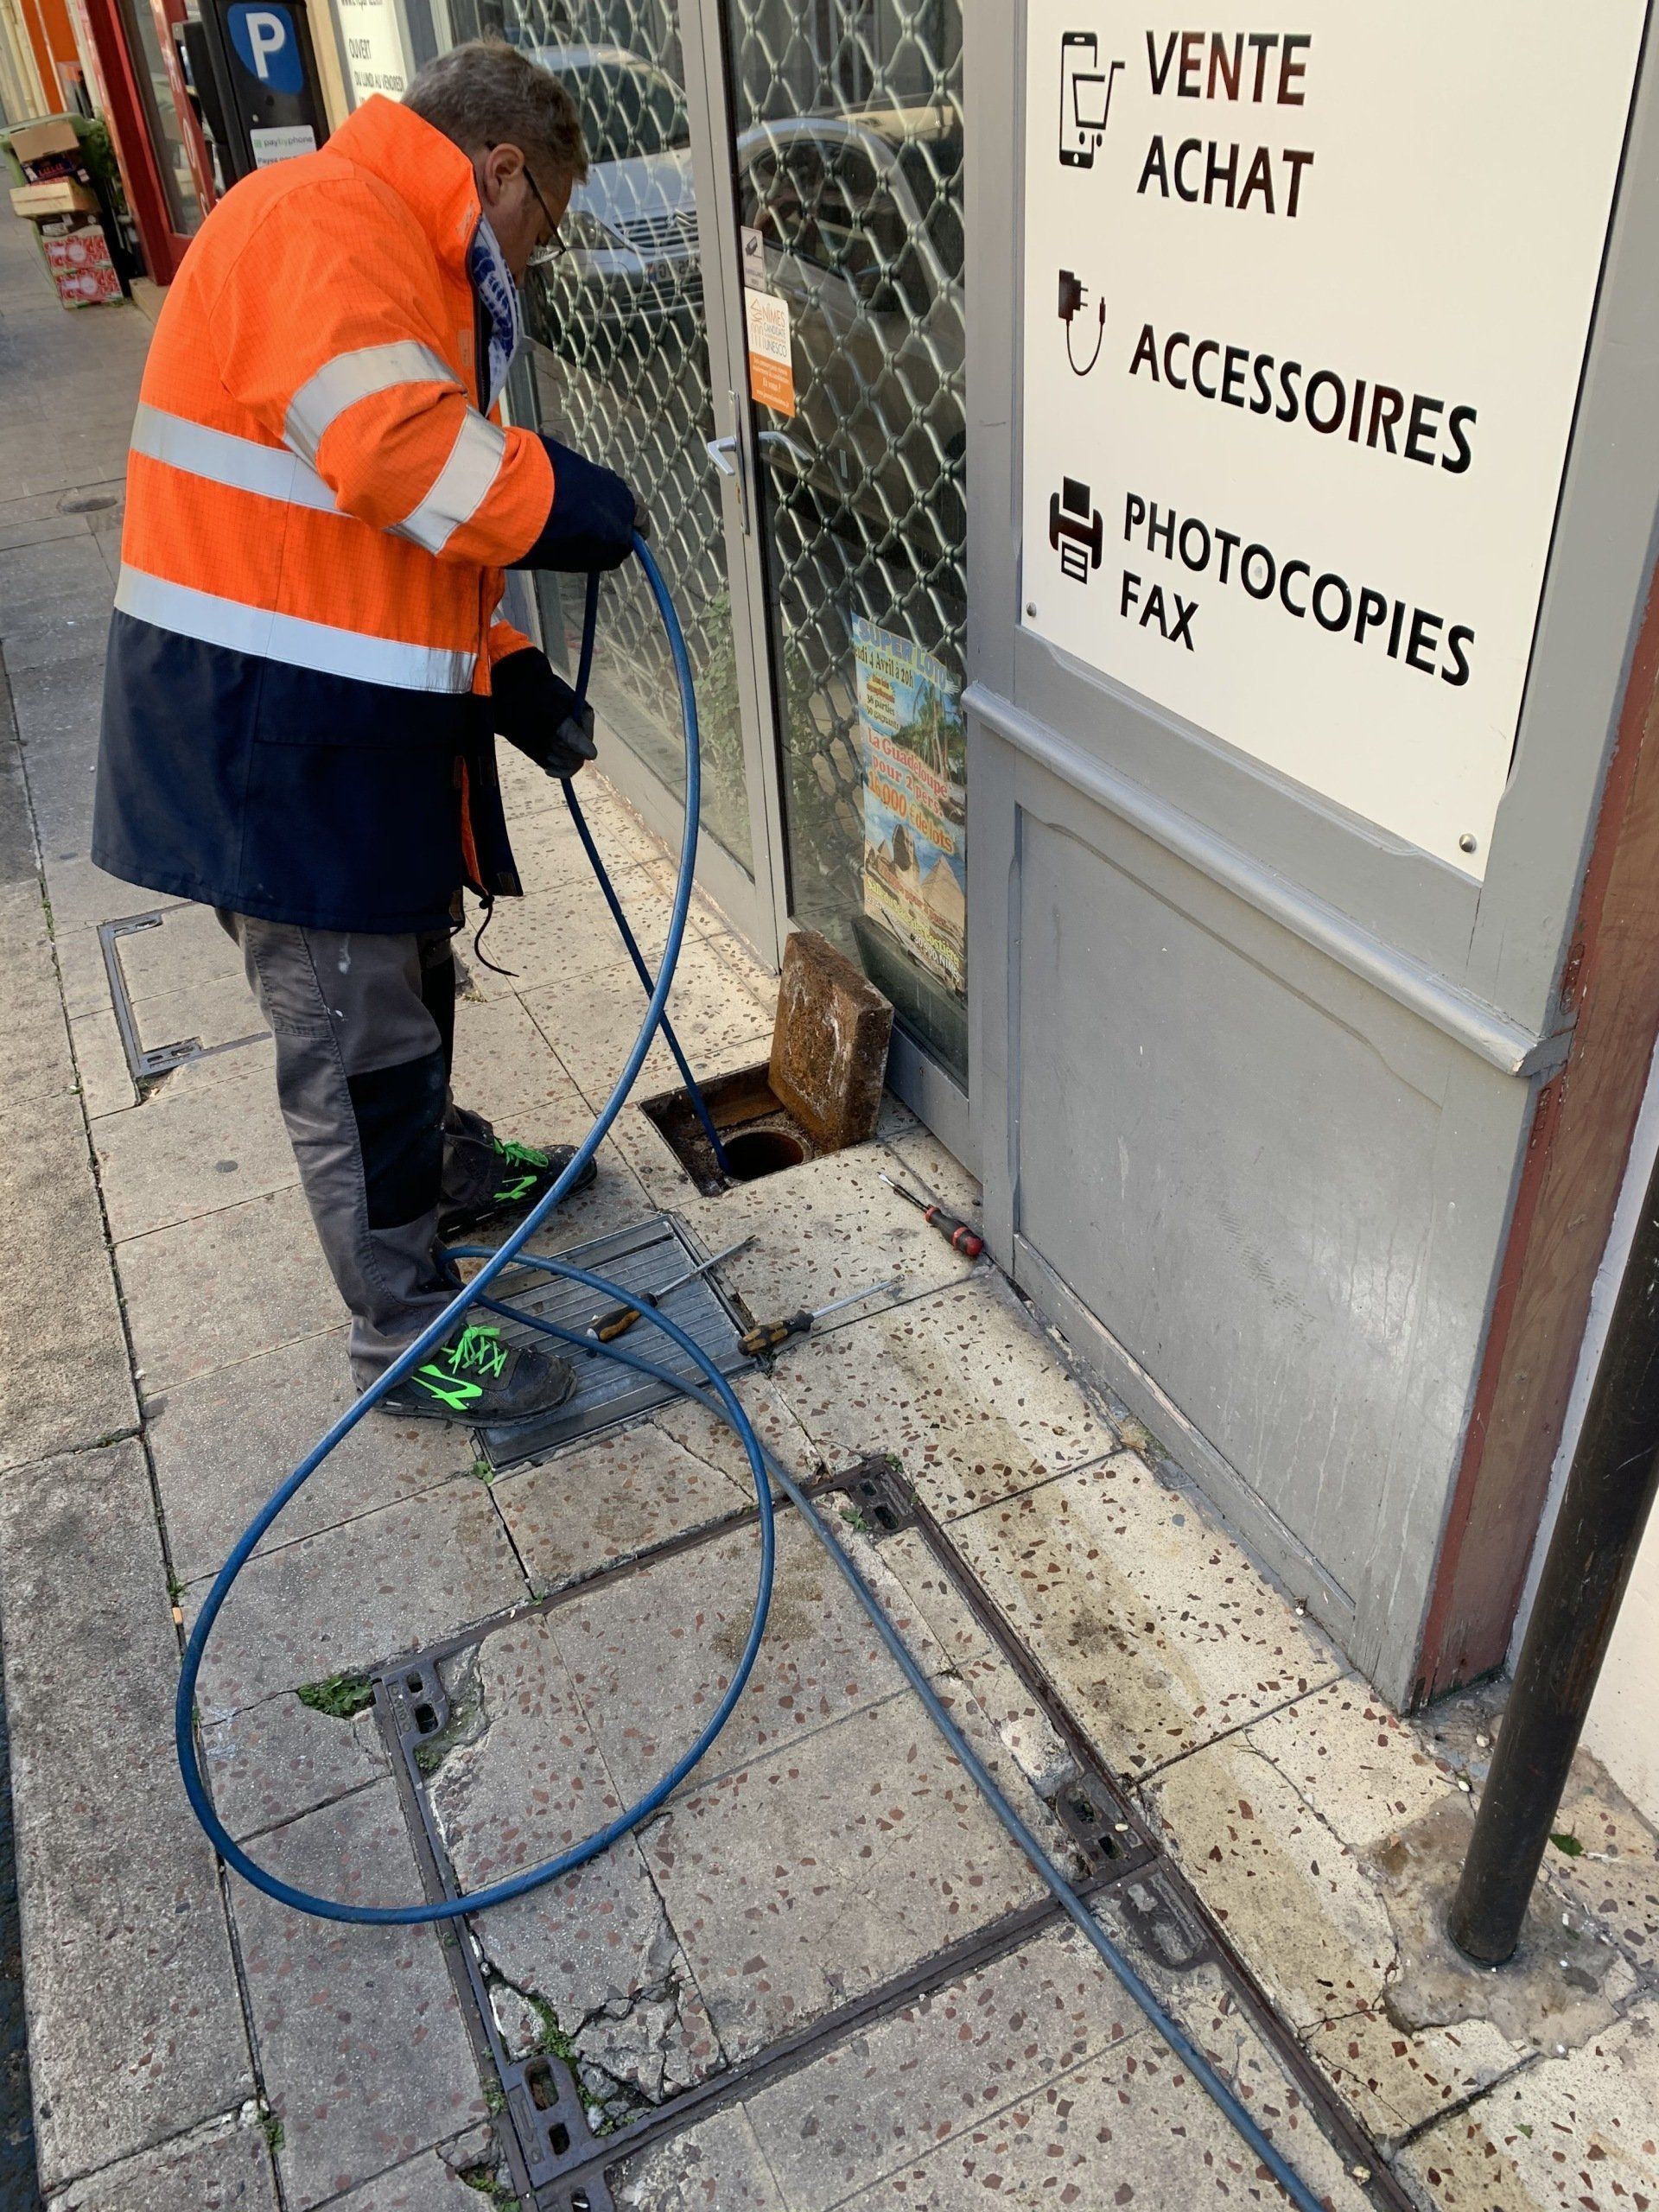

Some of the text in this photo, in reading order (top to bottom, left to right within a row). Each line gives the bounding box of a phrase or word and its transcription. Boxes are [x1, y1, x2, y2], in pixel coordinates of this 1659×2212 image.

[245, 11, 285, 79] P
[349, 38, 372, 60] OUVERT
[1146, 30, 1312, 106] VENTE
[354, 71, 362, 86] DU
[362, 72, 374, 88] LUNDI
[383, 74, 404, 92] VENDREDI
[264, 137, 313, 149] paybyphone
[1136, 135, 1315, 218] ACHAT
[765, 338, 787, 358] UNESCO
[1128, 323, 1478, 474] ACCESSOIRES
[1120, 569, 1199, 652] FAX
[1123, 492, 1475, 687] PHOTOCOPIES
[859, 620, 947, 690] SUPER LOTO
[875, 652, 894, 677] Avril
[901, 668, 913, 689] 20h
[868, 727, 948, 798] La Guadeloupe
[873, 755, 944, 817] pour 2 pers.
[916, 812, 927, 834] de
[930, 823, 954, 853] lots
